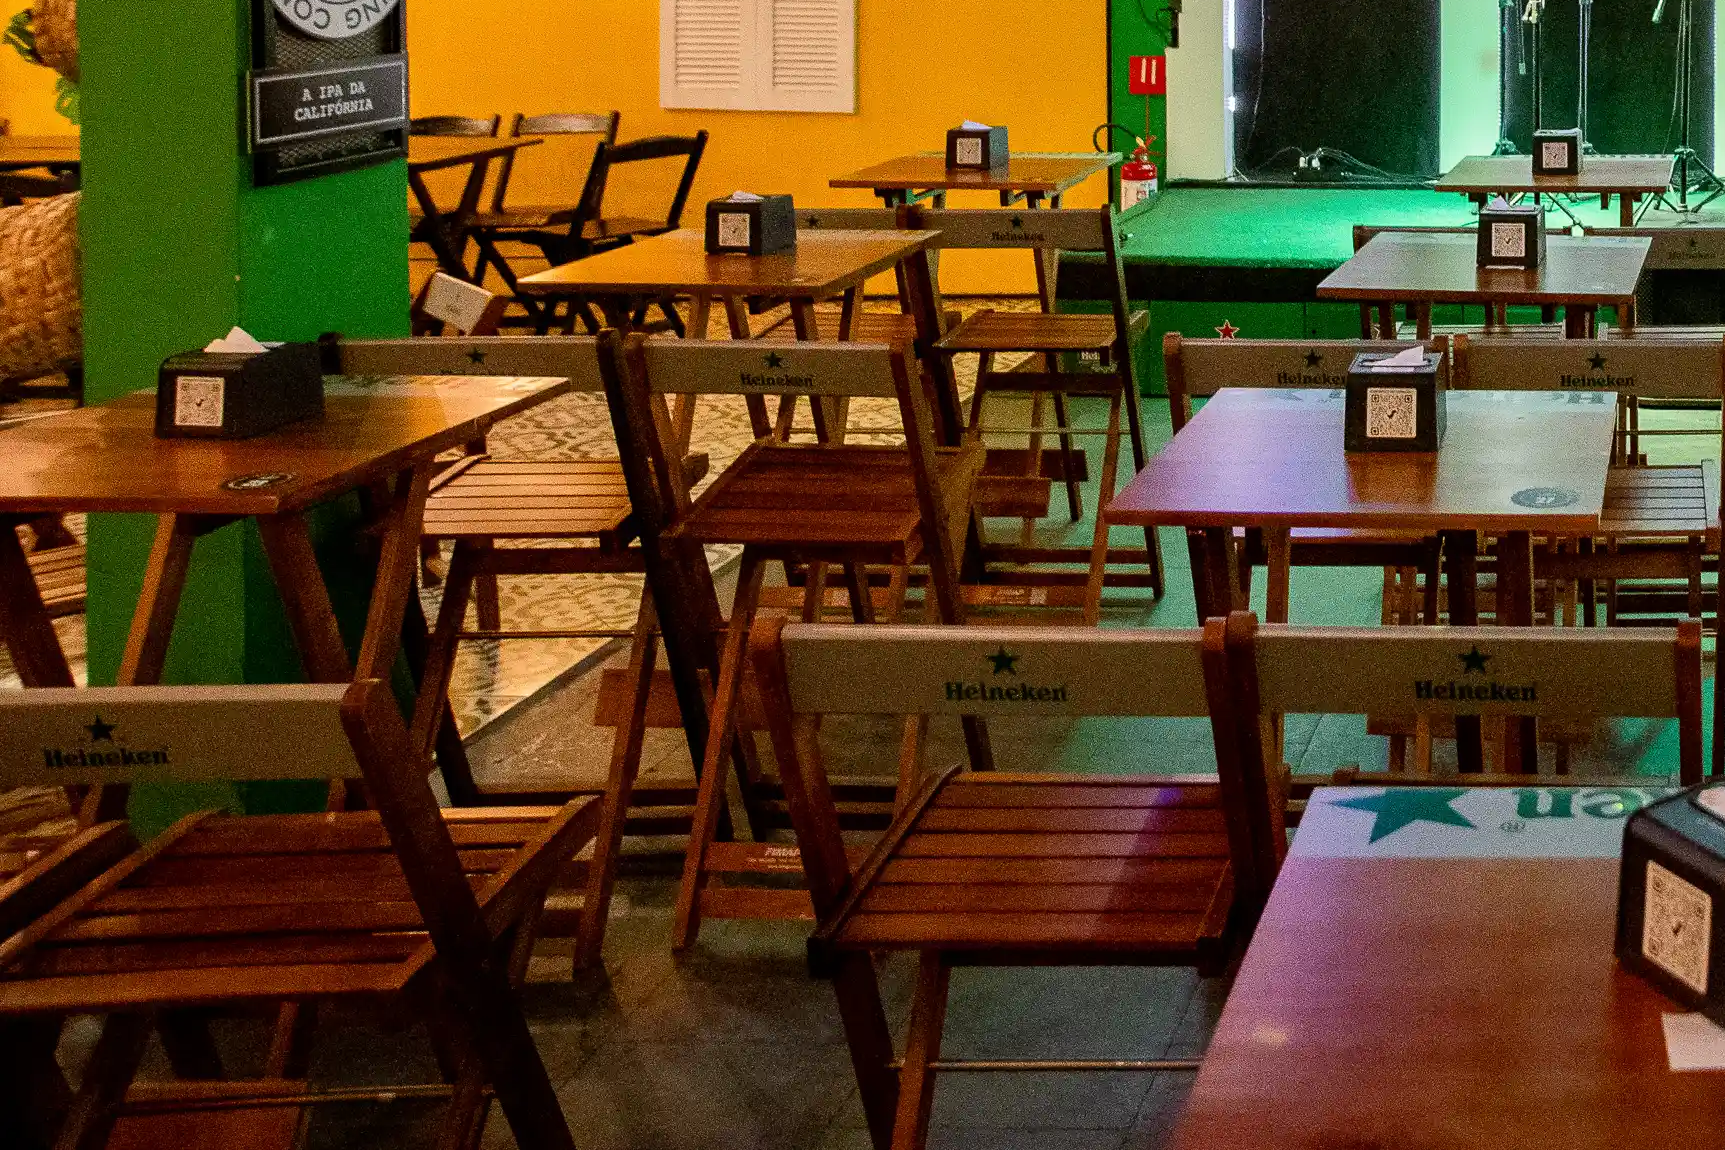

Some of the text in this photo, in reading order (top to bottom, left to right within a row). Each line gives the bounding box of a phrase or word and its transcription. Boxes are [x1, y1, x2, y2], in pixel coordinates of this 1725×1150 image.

[302, 81, 366, 102] A IPA DA
[294, 98, 373, 122] CALIFÓRNIA
[740, 372, 814, 388] Heineken
[1560, 374, 1635, 388] Heineken
[945, 681, 1068, 702] Heineken
[1415, 680, 1538, 702] Heineken
[44, 745, 170, 768] Heineken
